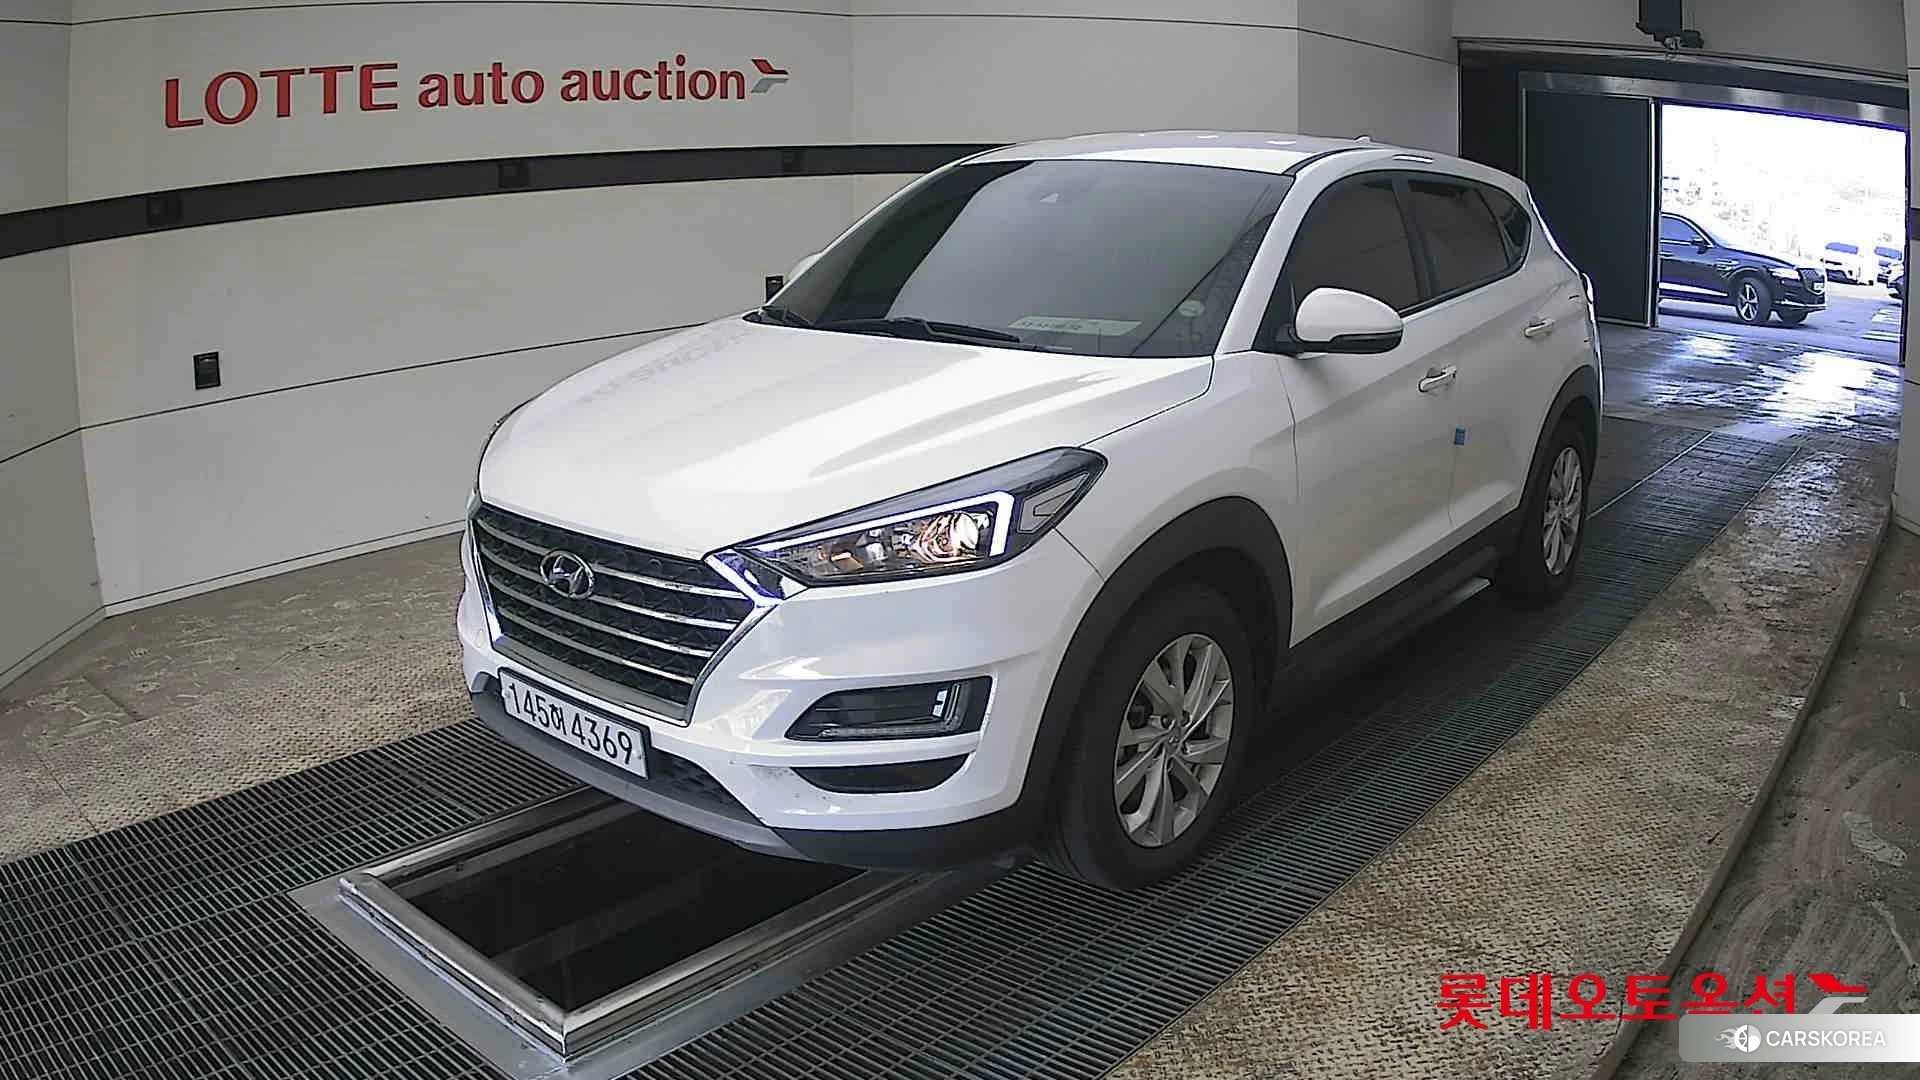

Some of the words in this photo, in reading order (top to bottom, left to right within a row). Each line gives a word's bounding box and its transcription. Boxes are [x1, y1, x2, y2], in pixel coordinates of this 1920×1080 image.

[164, 63, 398, 128] LOTTE
[418, 62, 545, 108] auto
[560, 55, 747, 102] auction
